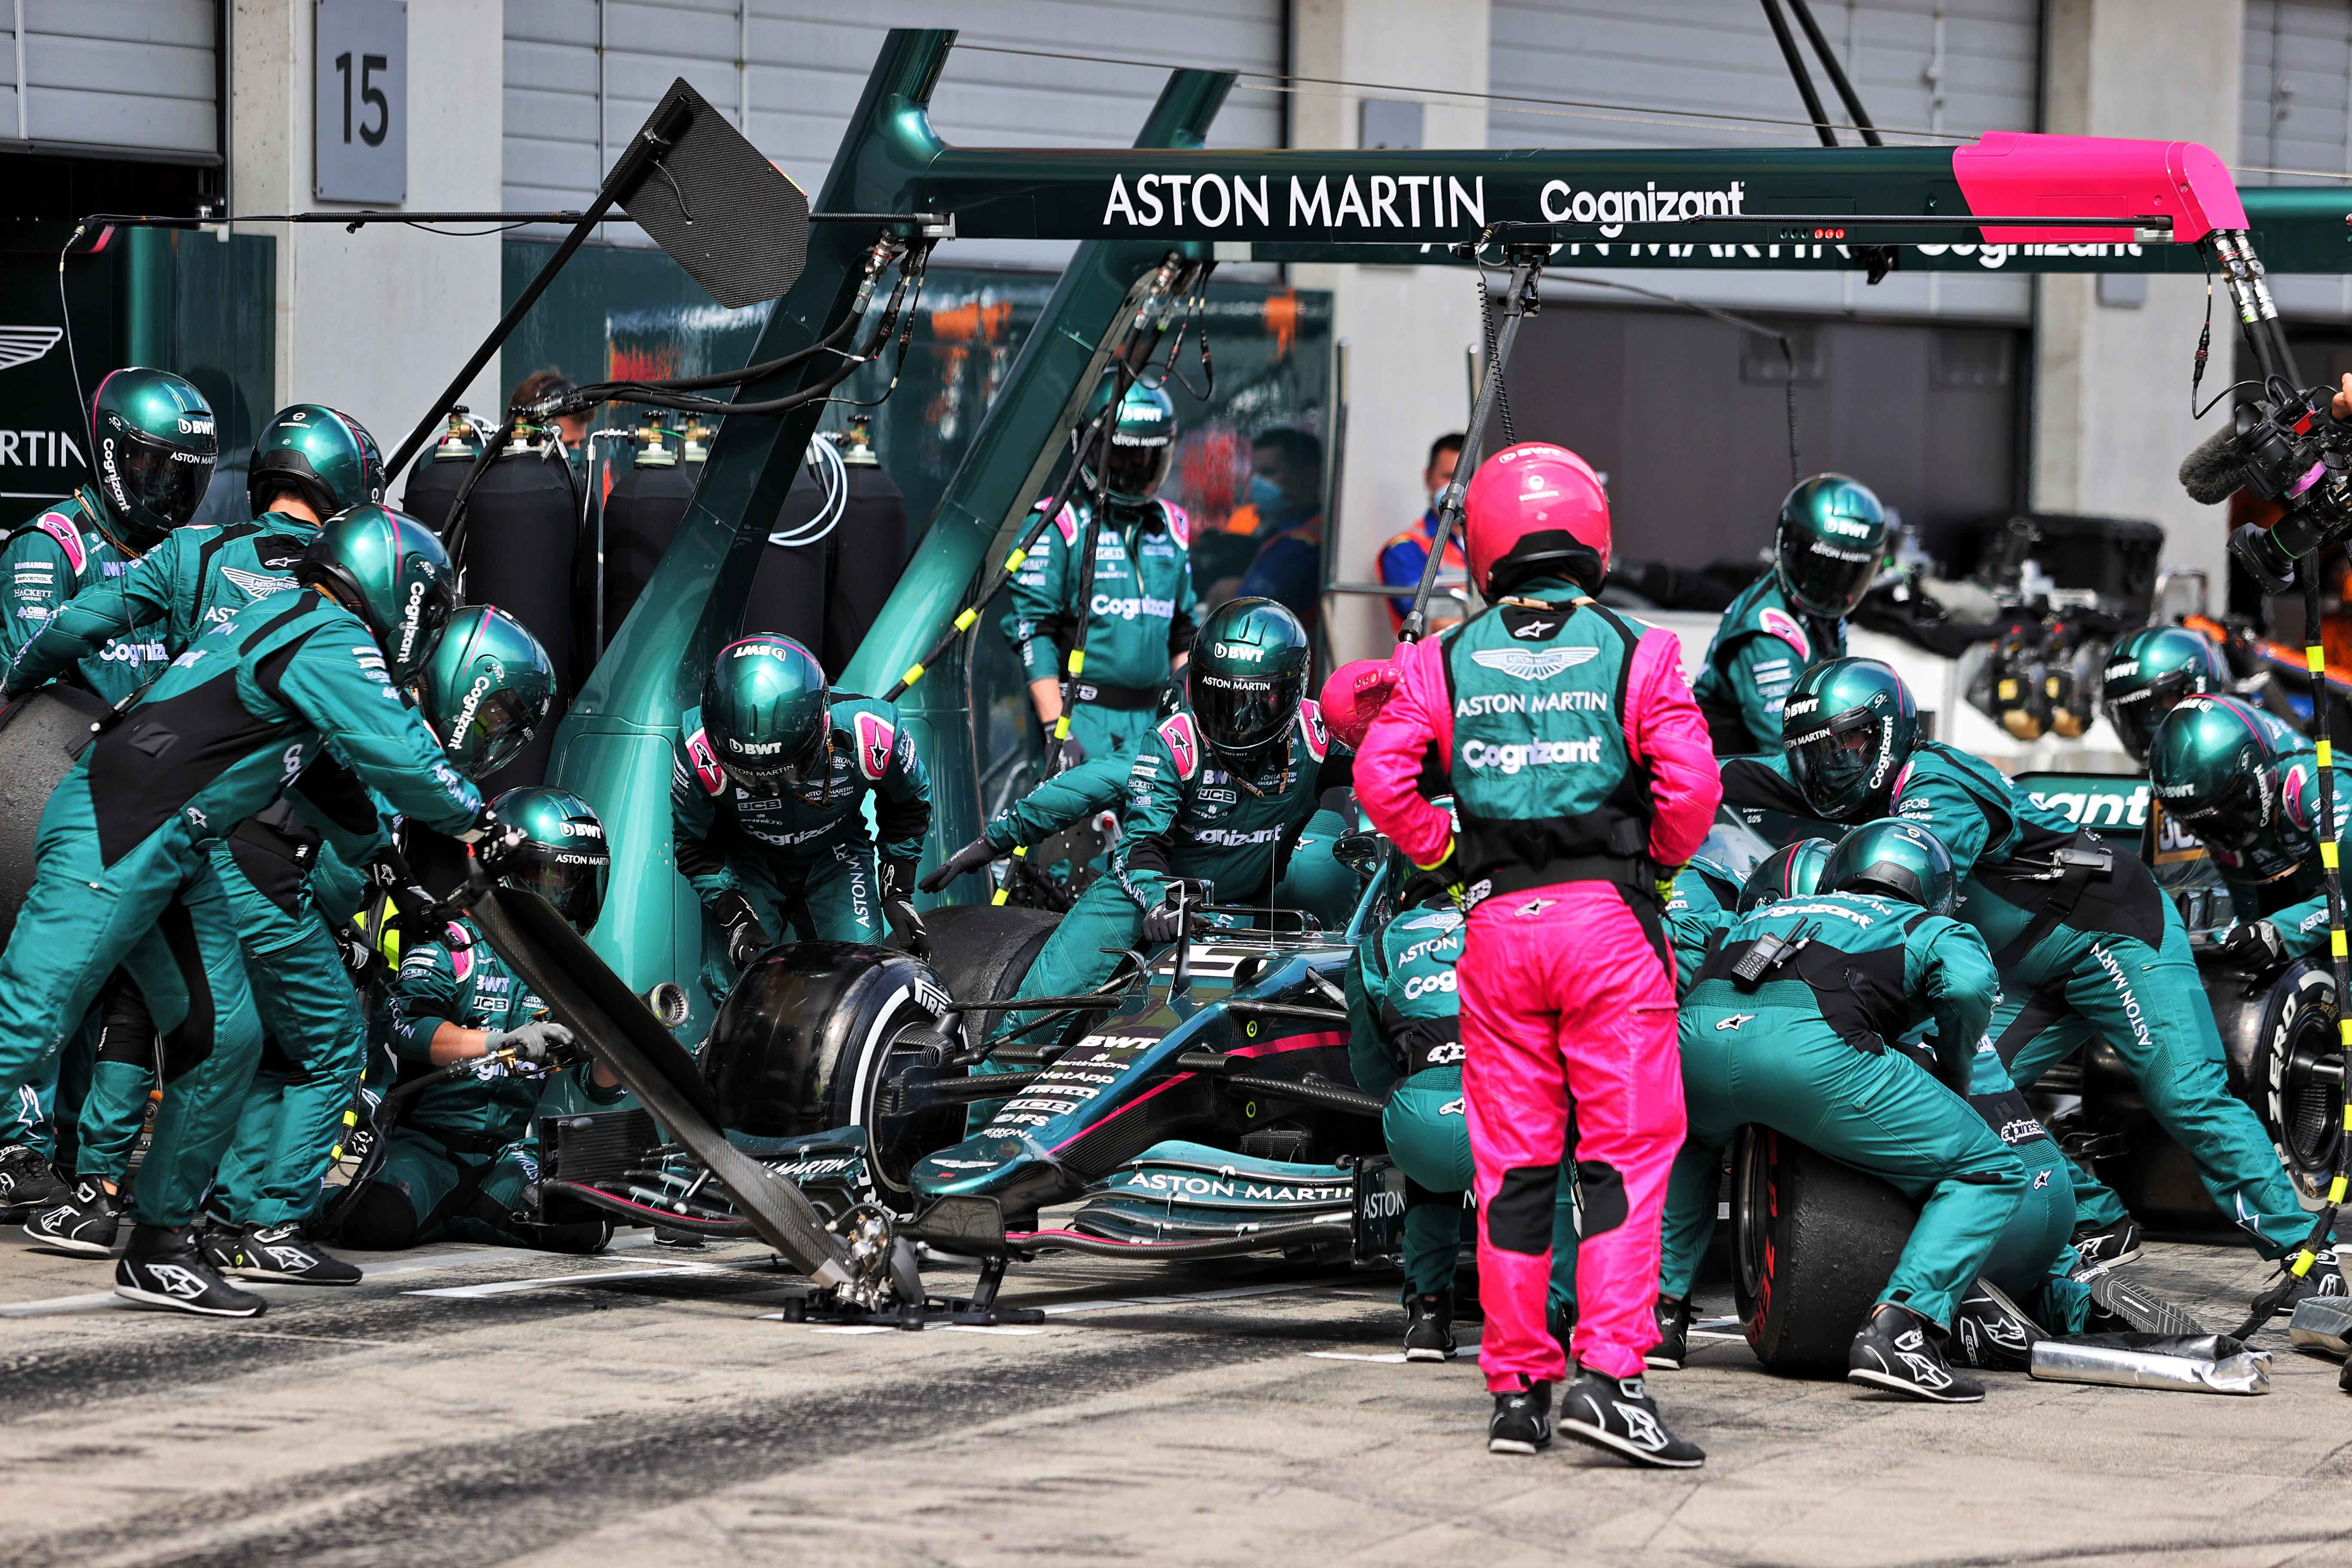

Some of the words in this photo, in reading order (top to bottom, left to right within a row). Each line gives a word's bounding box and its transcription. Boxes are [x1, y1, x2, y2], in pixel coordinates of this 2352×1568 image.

[335, 52, 388, 147] 15
[1103, 173, 1270, 229] ASTON
[1289, 174, 1485, 229] MARTIN
[1540, 179, 1746, 238] Cognizant
[1133, 407, 1162, 422] BWT
[192, 420, 215, 436] BWT
[1112, 435, 1138, 447] ASTON
[1139, 435, 1169, 447] MARTIN
[170, 451, 199, 464] ASTON
[103, 438, 131, 512] Cognizant
[1838, 520, 1871, 539] BWT
[1810, 542, 1841, 559] ASTON
[1840, 551, 1871, 563] MARTIN
[254, 580, 276, 588] ASTON
[14, 589, 53, 598] HACKETT
[26, 606, 49, 616] Cillit
[396, 581, 426, 664] Cognizant
[1228, 646, 1265, 662] BWT
[2111, 661, 2140, 680] BWT
[1202, 676, 1231, 689] ASTON
[1233, 680, 1271, 691] MARTIN
[2119, 687, 2153, 705] MARTIN
[1455, 693, 1526, 718] ASTON
[1531, 691, 1608, 714] MARTIN
[1790, 698, 1819, 717] BWT
[448, 676, 490, 750] Cognizant
[1798, 728, 1831, 745] MARTIN
[744, 742, 782, 755] BWT
[1462, 735, 1602, 775] Cognizant
[1870, 715, 1893, 790] Cognizant
[723, 762, 753, 776] ASTON
[756, 763, 794, 777] MARTIN
[828, 786, 854, 794] MARTIN
[1128, 779, 1154, 790] HACKETT
[2165, 783, 2195, 798] BWT
[1199, 790, 1236, 803] JCB
[738, 800, 780, 811] JCB
[1899, 798, 1930, 813] EPOS
[1902, 812, 1933, 821] NetApp
[575, 824, 602, 839] BWT
[1893, 833, 1928, 851] SCHUBERTH
[555, 853, 587, 865] ASTON
[589, 855, 610, 866] MARTIN
[851, 871, 870, 928] ASTON
[1398, 936, 1458, 970] ASTON
[476, 974, 510, 993] BWT
[2119, 989, 2153, 1046] ASTON
[1077, 1035, 1161, 1050] BWT
[1051, 1060, 1131, 1071] SentinelOne
[2268, 991, 2297, 1124] ZERO
[1034, 1071, 1115, 1084] NetApp
[1017, 1084, 1101, 1100] PIRELLI
[1011, 1113, 1050, 1127] IFS
[776, 1159, 855, 1175] MARTIN
[1127, 1172, 1235, 1198] ASTON
[1363, 1191, 1405, 1220] ASTON
[1749, 1234, 1775, 1346] ZERO
